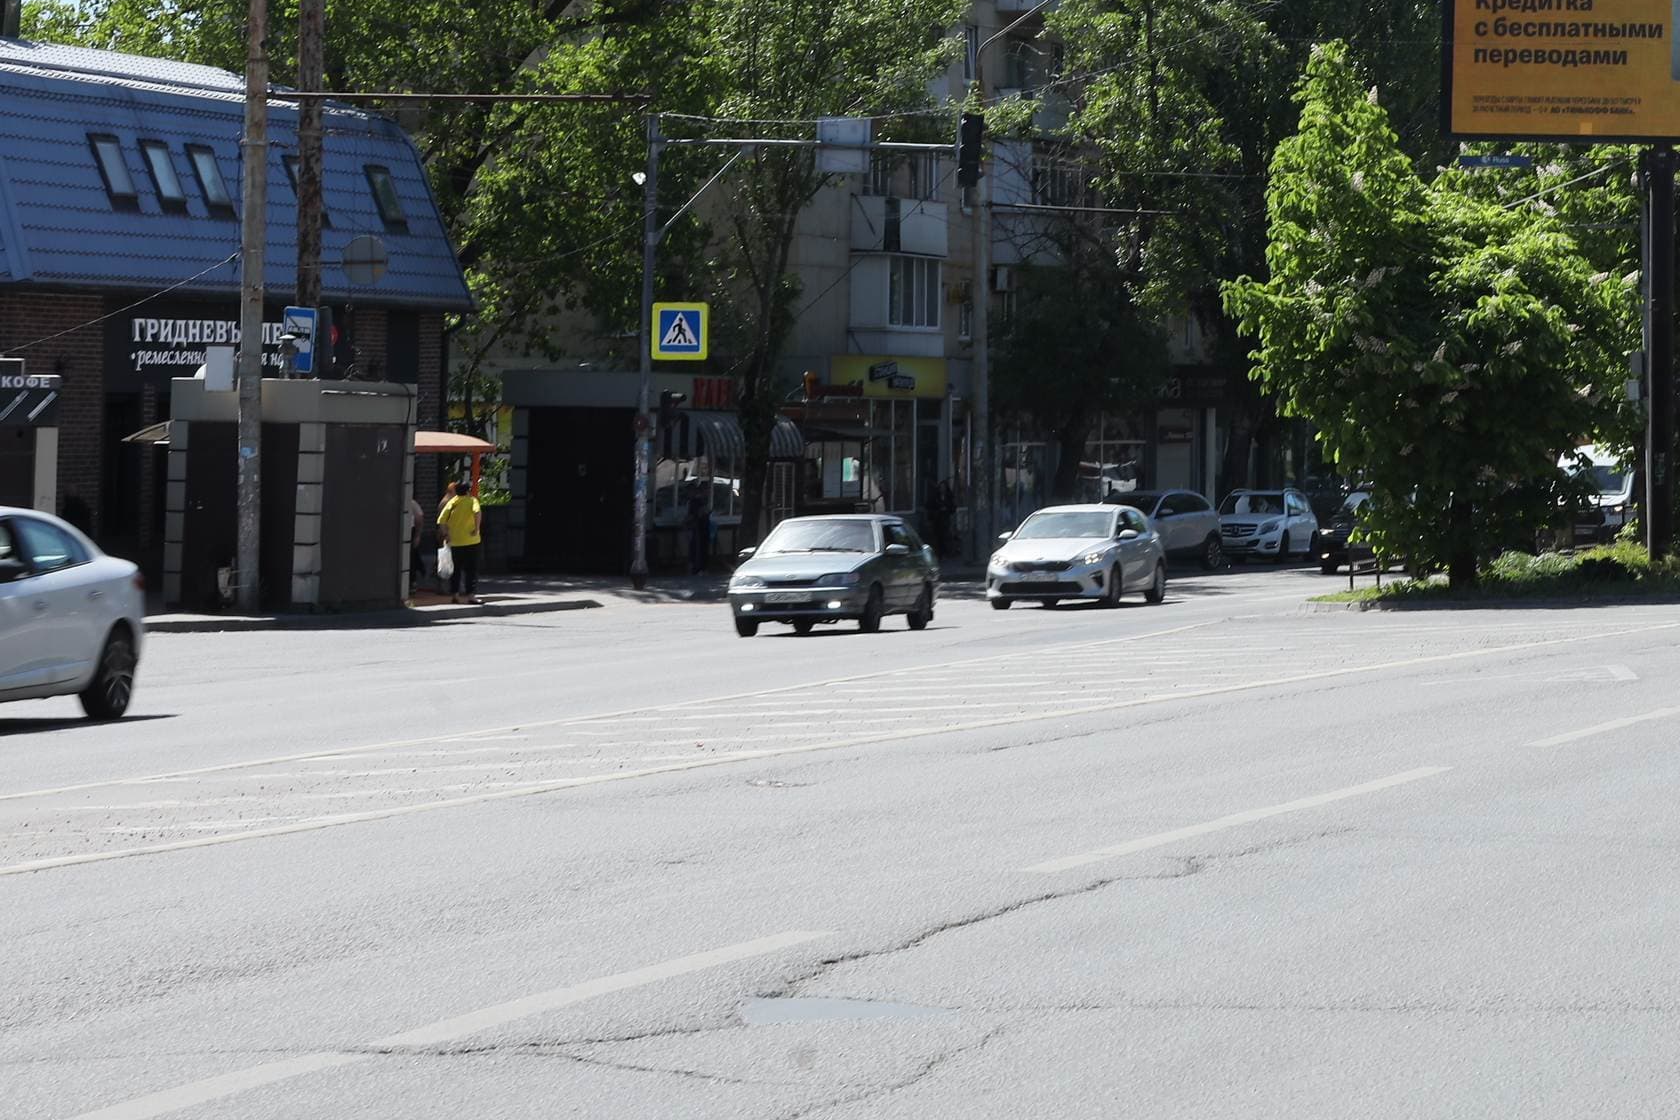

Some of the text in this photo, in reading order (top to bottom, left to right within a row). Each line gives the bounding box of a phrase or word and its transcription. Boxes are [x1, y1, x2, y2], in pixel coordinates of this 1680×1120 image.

[1475, 17, 1664, 38] с бесплатными
[1474, 48, 1628, 67] переводами
[132, 318, 241, 347] ГРИДНЕВЪ
[1, 375, 51, 388] КОФЕ
